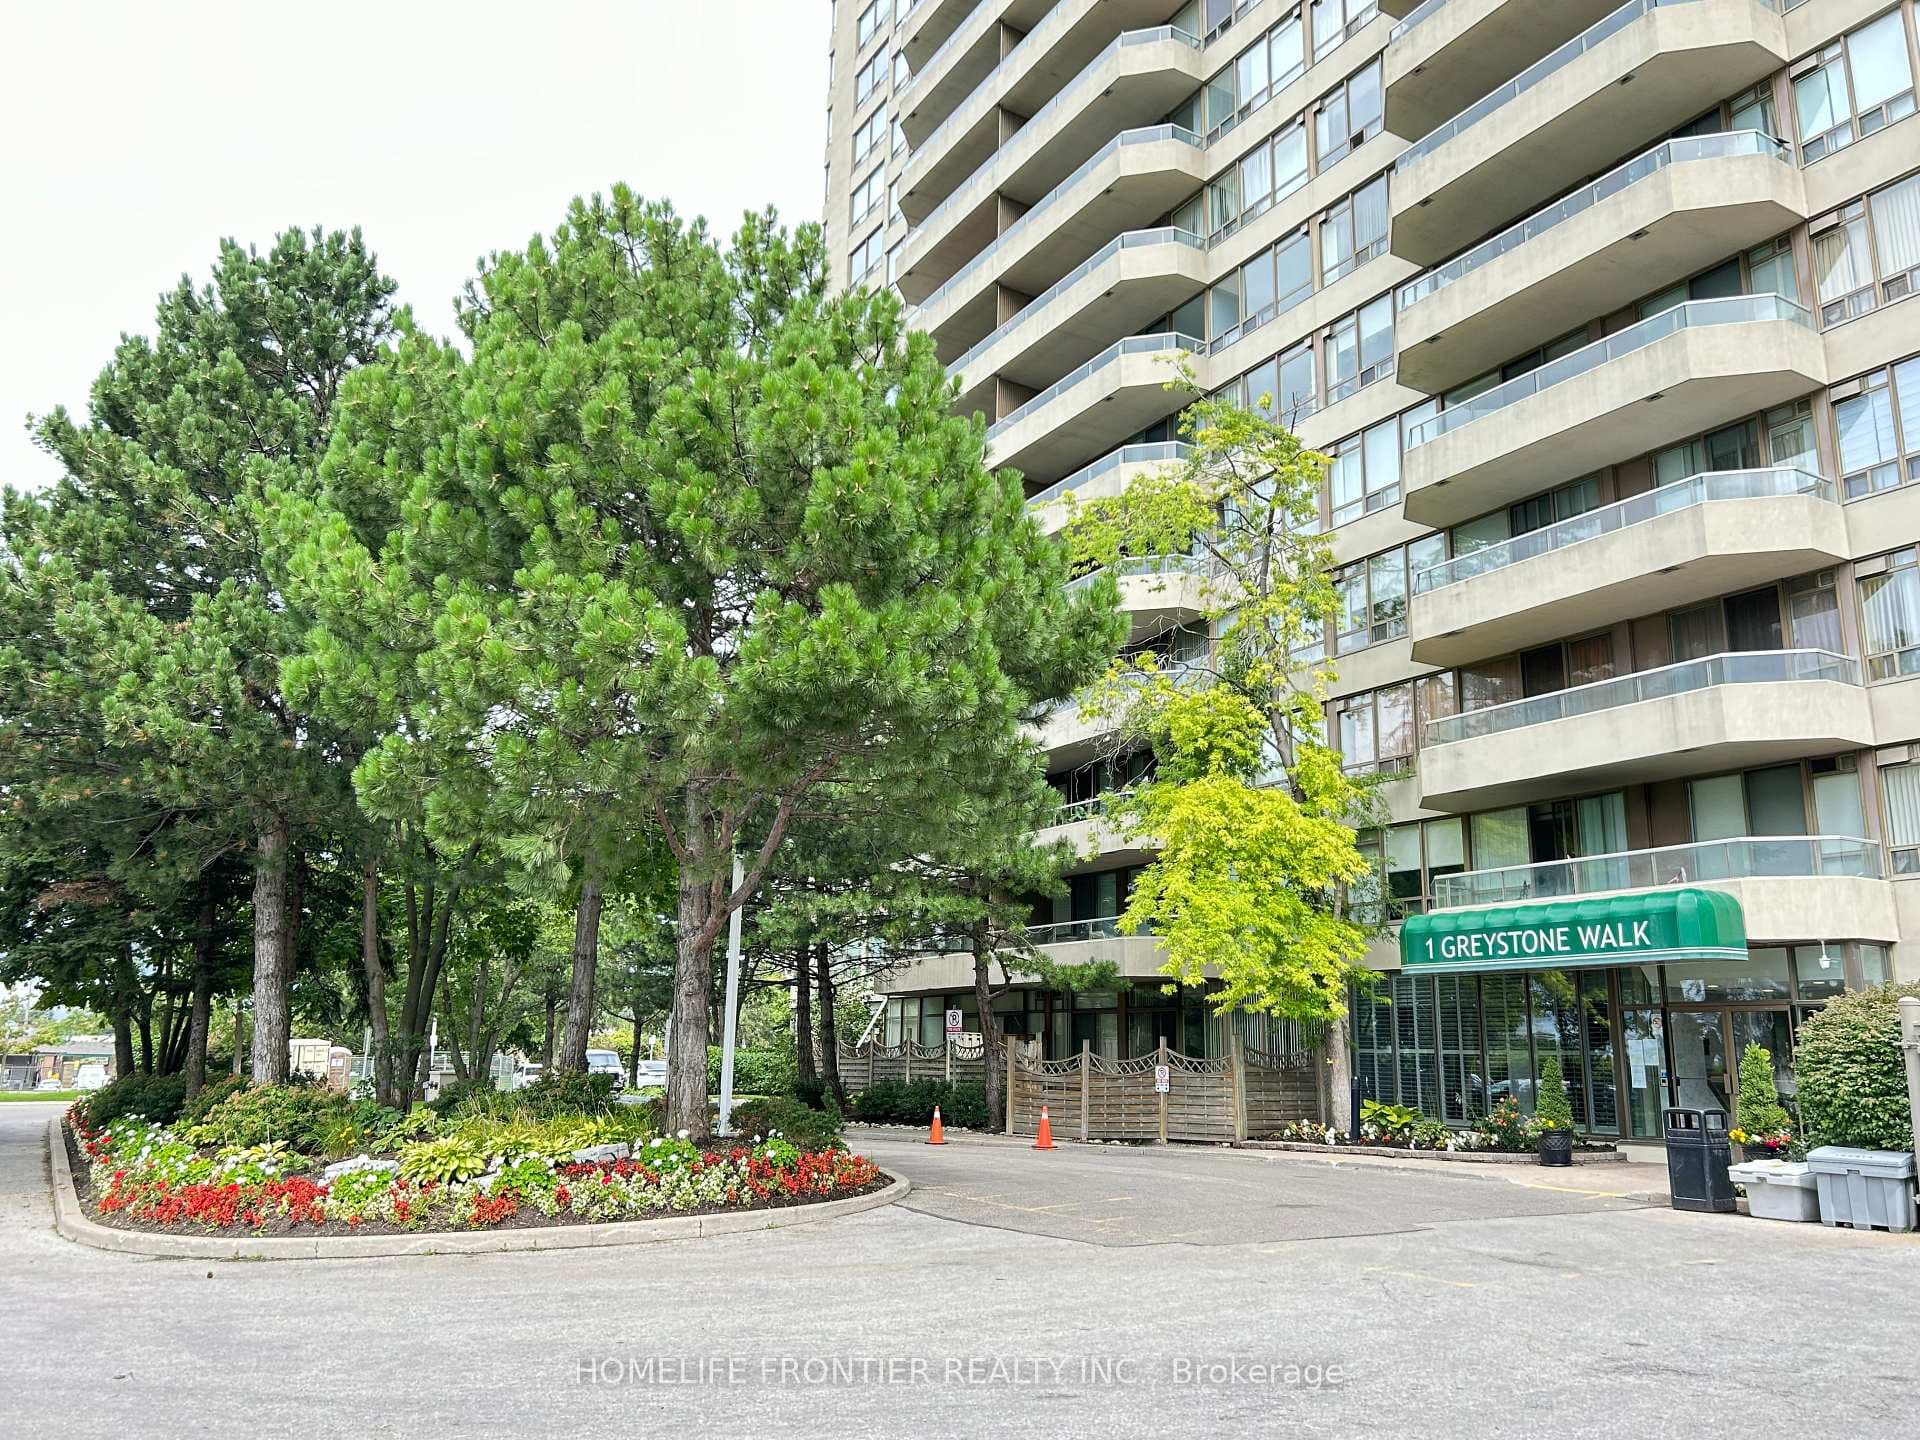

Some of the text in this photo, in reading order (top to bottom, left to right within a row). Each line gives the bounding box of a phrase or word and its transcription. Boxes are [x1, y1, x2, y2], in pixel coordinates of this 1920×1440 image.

[1425, 920, 1652, 960] 1 GREYSTONE WALK
